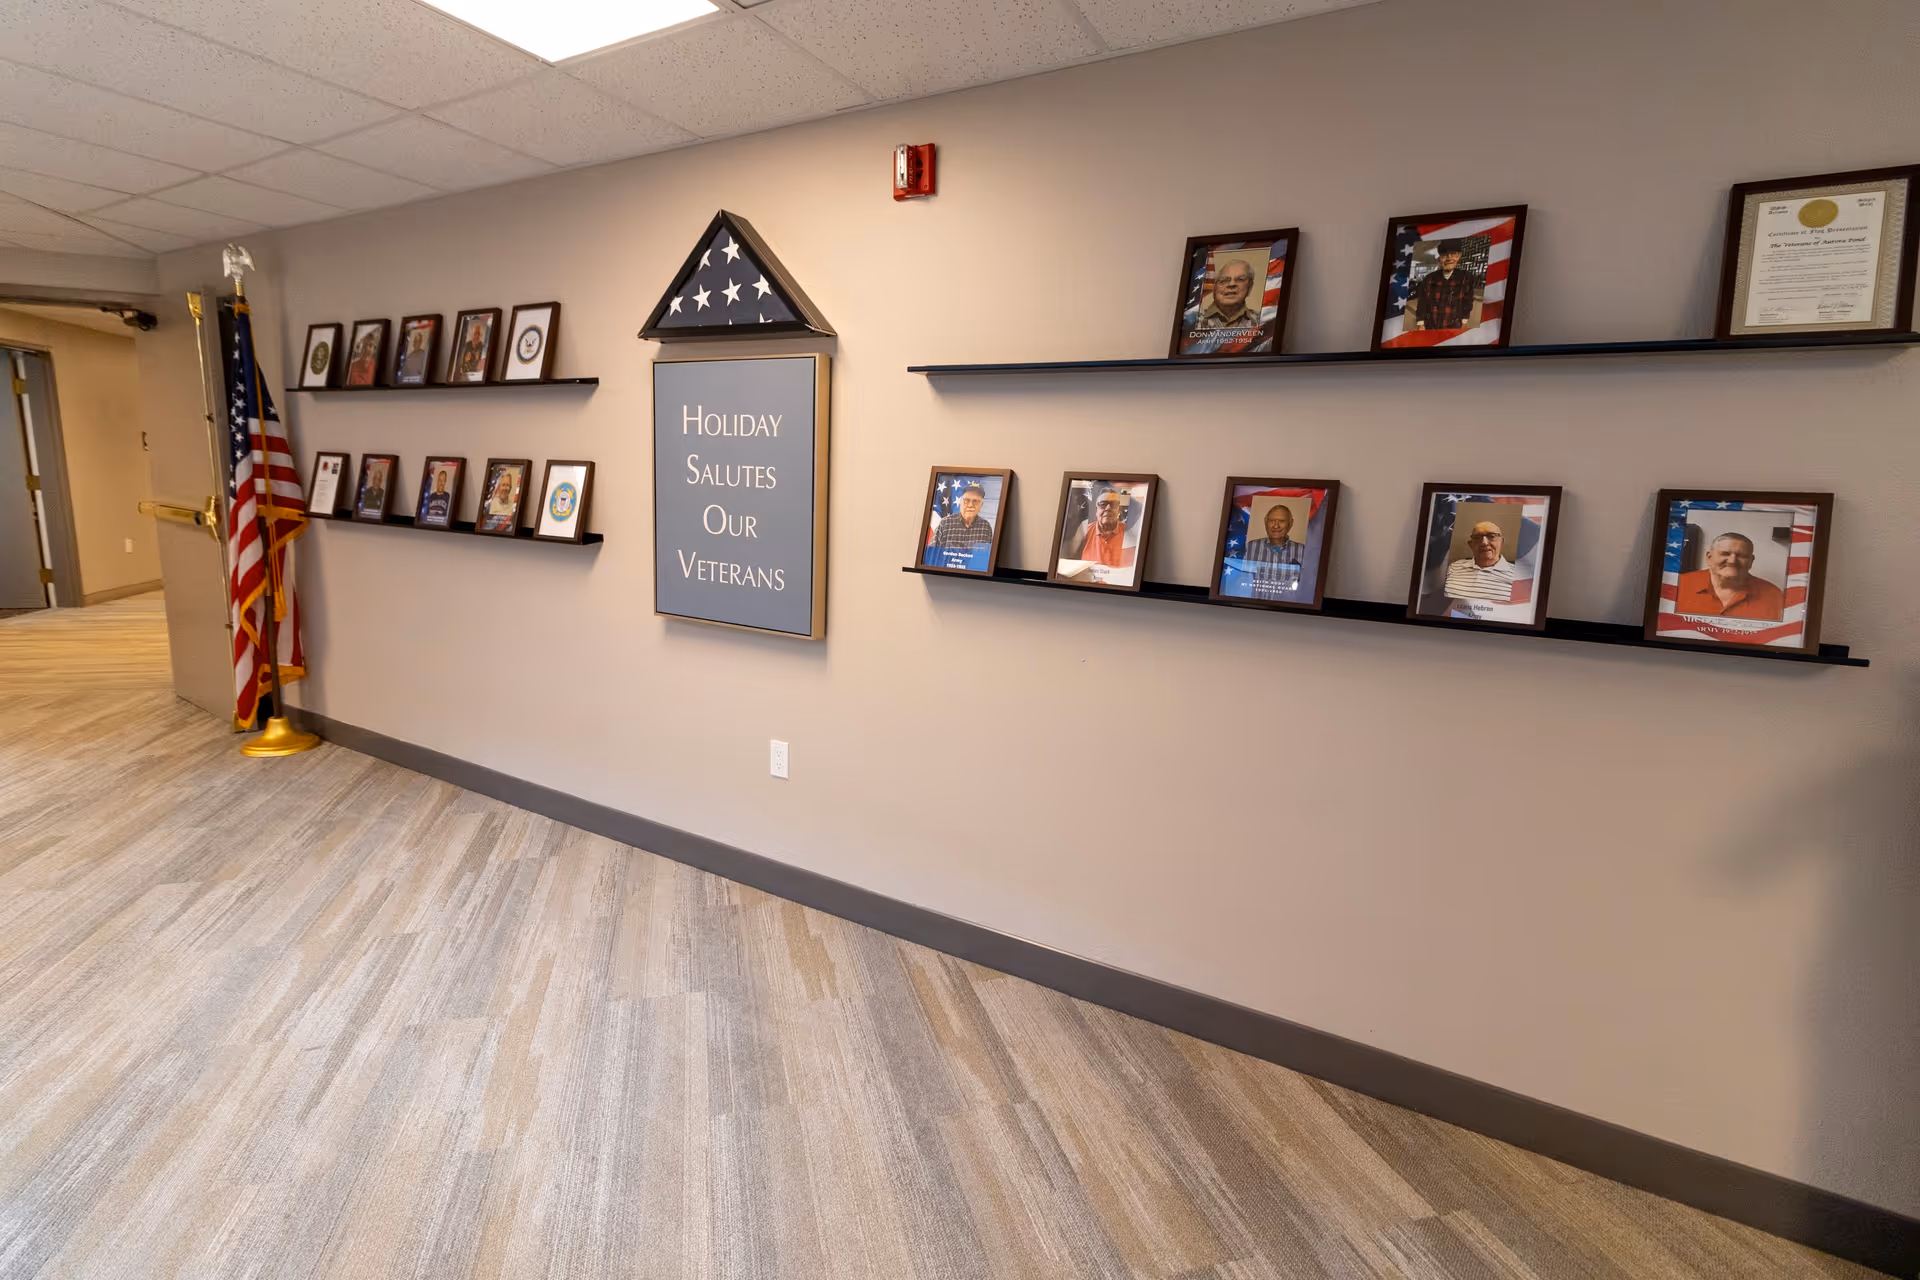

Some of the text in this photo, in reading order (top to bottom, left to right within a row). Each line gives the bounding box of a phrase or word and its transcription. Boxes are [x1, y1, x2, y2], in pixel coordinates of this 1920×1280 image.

[1784, 240, 1812, 248] Veterans
[682, 405, 783, 437] HOLIDAY
[686, 454, 777, 489] SALUTES
[703, 504, 758, 538] OUR
[677, 549, 785, 591] VETERANS
